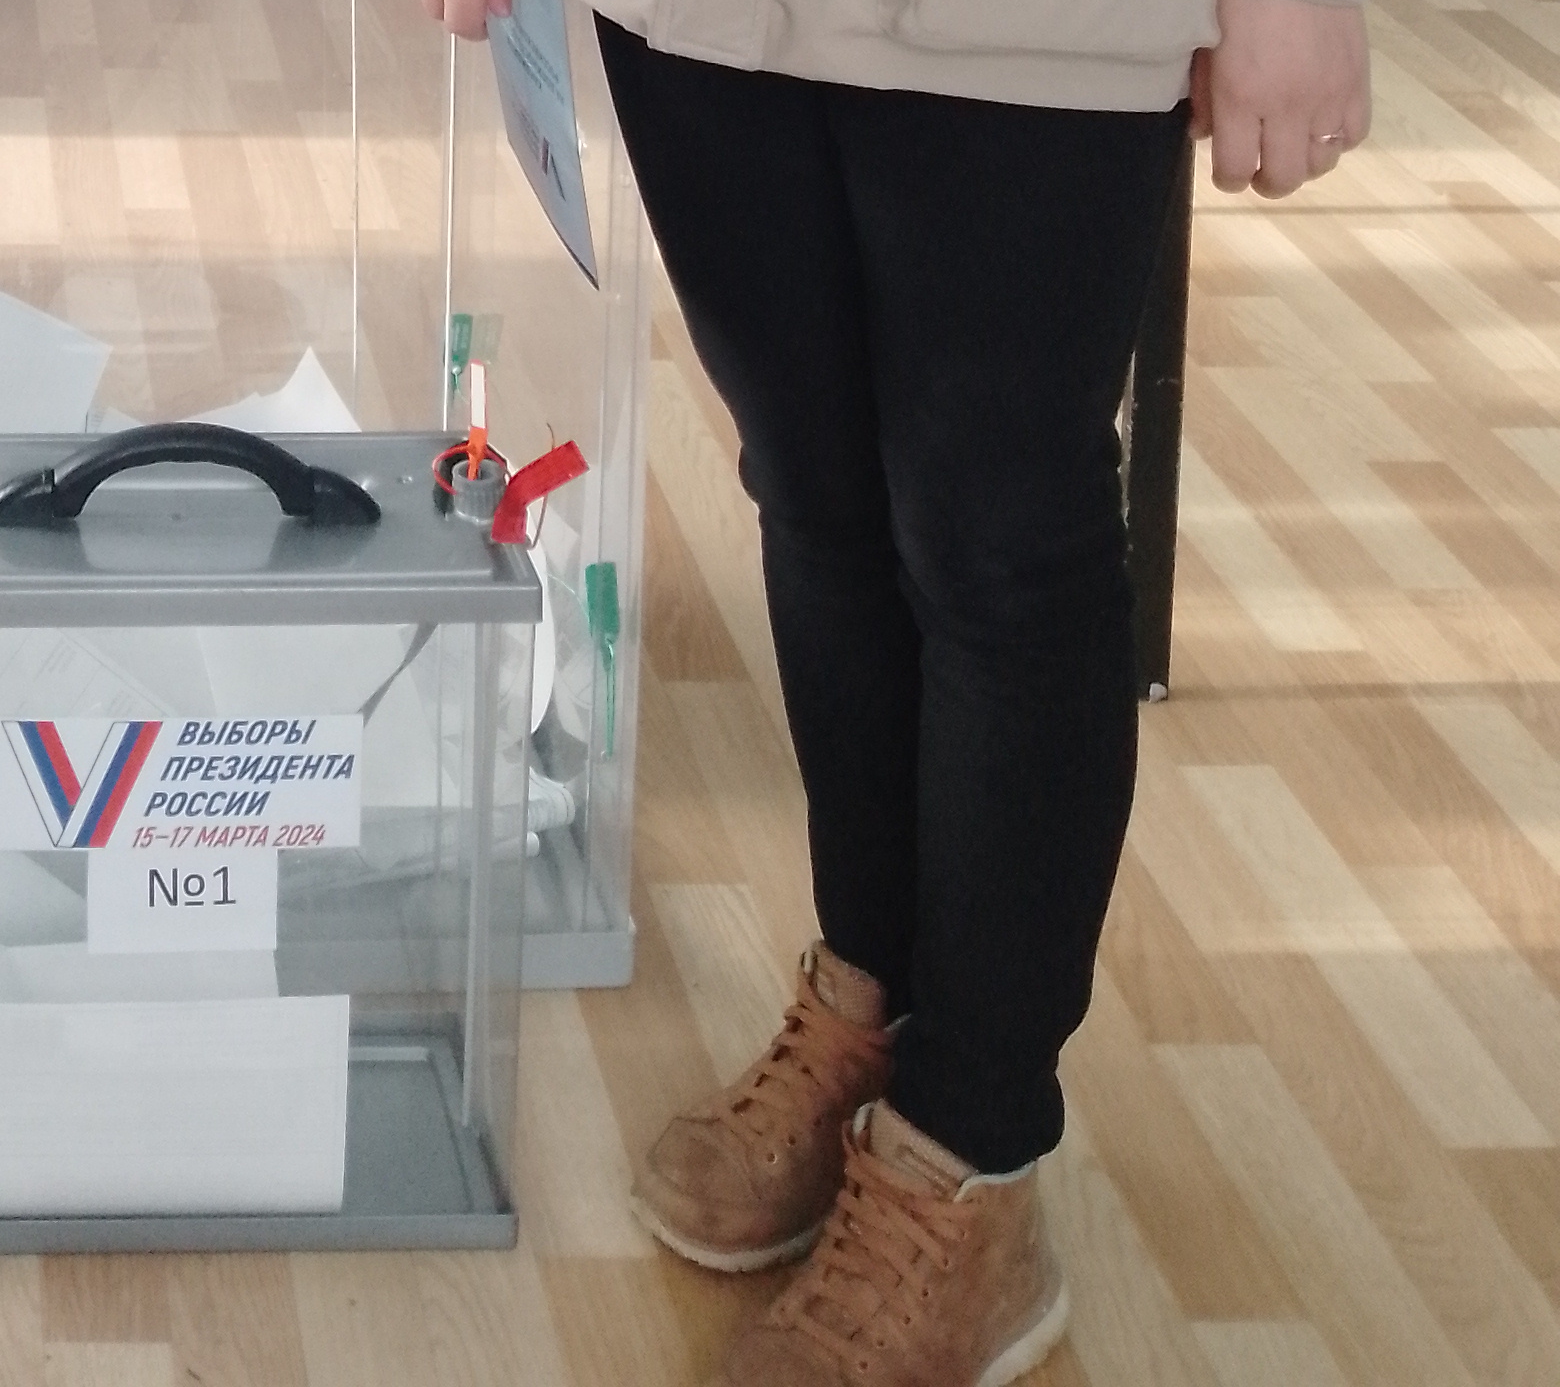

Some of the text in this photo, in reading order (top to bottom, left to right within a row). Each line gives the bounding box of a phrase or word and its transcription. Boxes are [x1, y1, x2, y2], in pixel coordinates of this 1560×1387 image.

[177, 718, 317, 746] ВЫБОРЫ
[159, 754, 355, 785] ПРЕЗИДЕНТА
[143, 791, 271, 817] РОССИИ
[194, 825, 270, 848] МАРТА
[271, 824, 327, 847] 2024
[148, 865, 237, 907] №1
